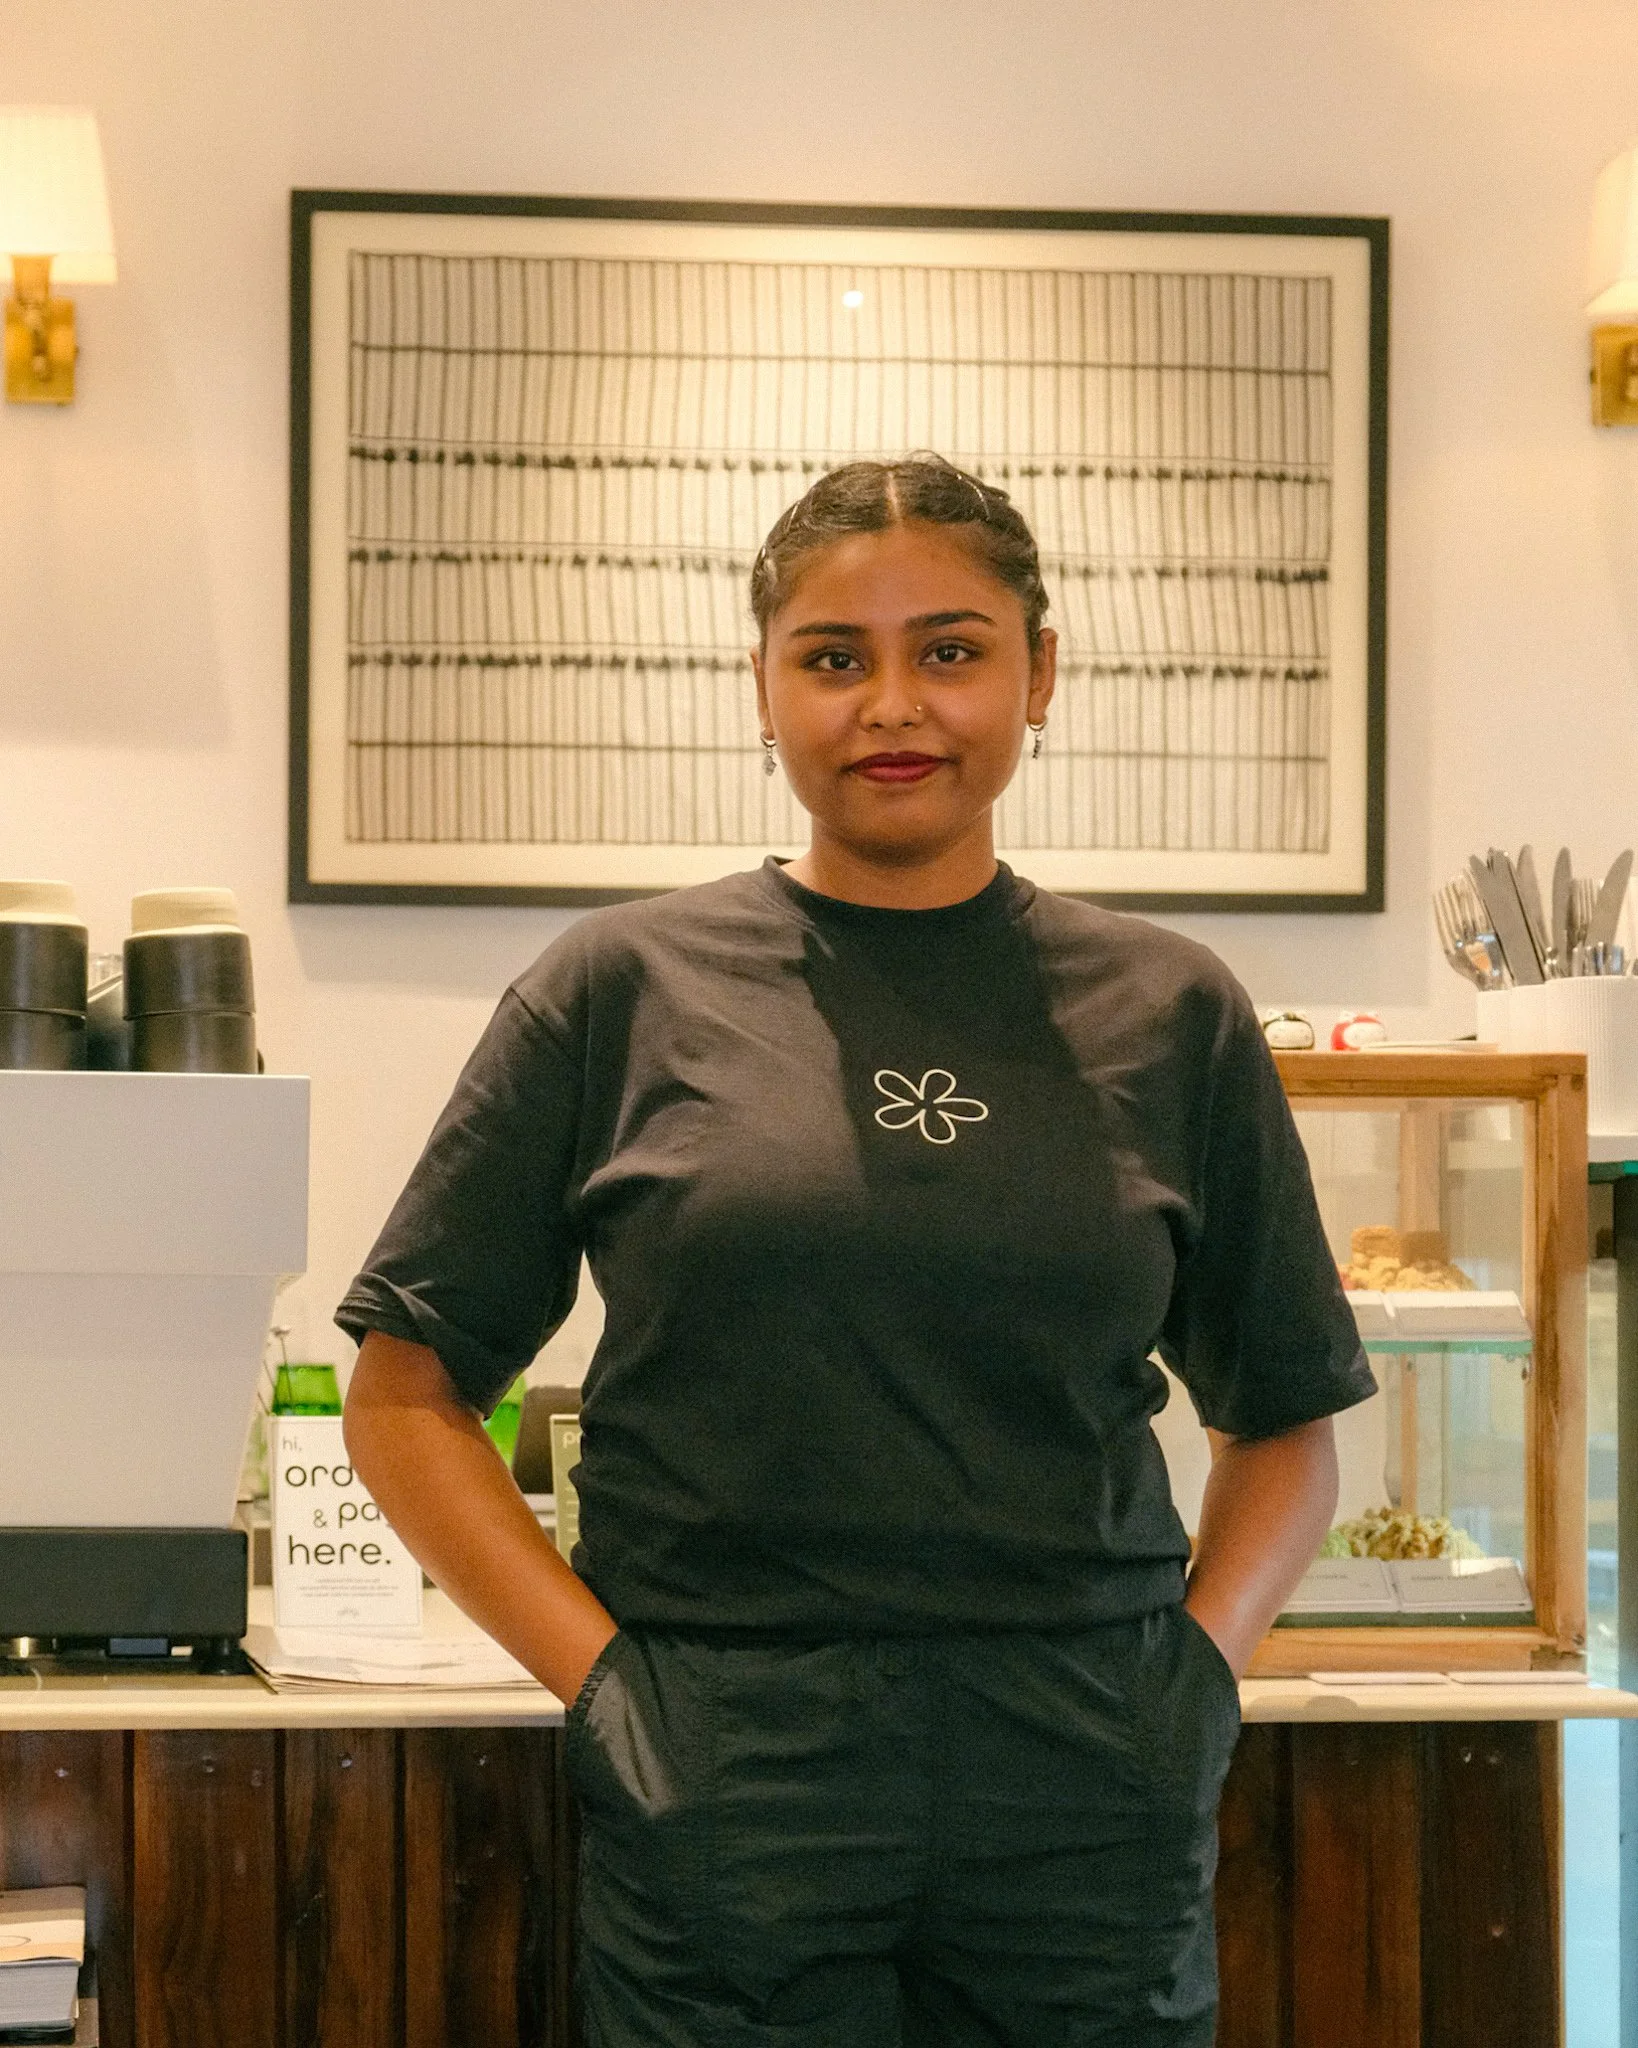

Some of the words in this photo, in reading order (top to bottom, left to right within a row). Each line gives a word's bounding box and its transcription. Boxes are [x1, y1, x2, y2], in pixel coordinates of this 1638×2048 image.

[285, 1464, 354, 1487] ord
[313, 1508, 328, 1529] &
[339, 1502, 381, 1529] pa
[288, 1535, 392, 1565] here.
